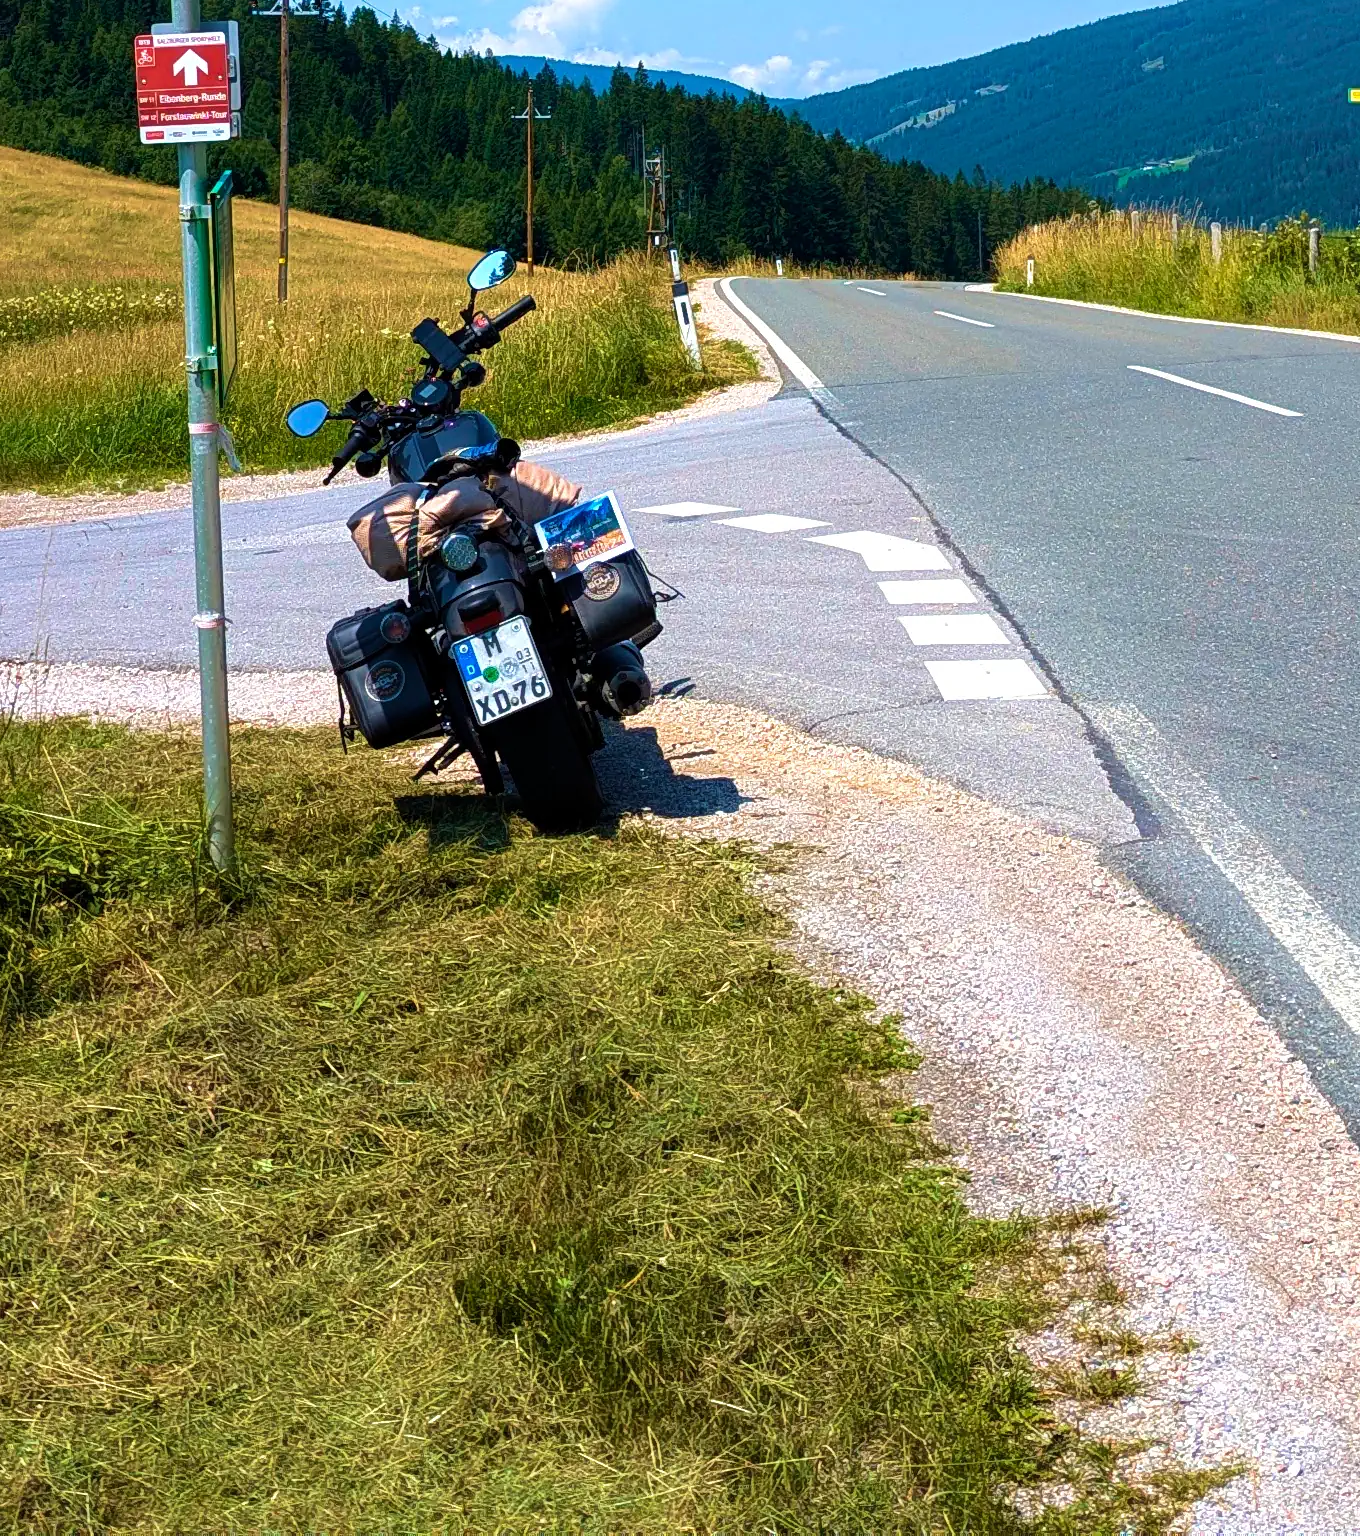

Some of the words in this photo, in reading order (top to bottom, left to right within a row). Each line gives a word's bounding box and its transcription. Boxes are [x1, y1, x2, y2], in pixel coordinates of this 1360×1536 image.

[482, 631, 502, 658] M
[516, 647, 531, 661] 03
[466, 665, 476, 675] D
